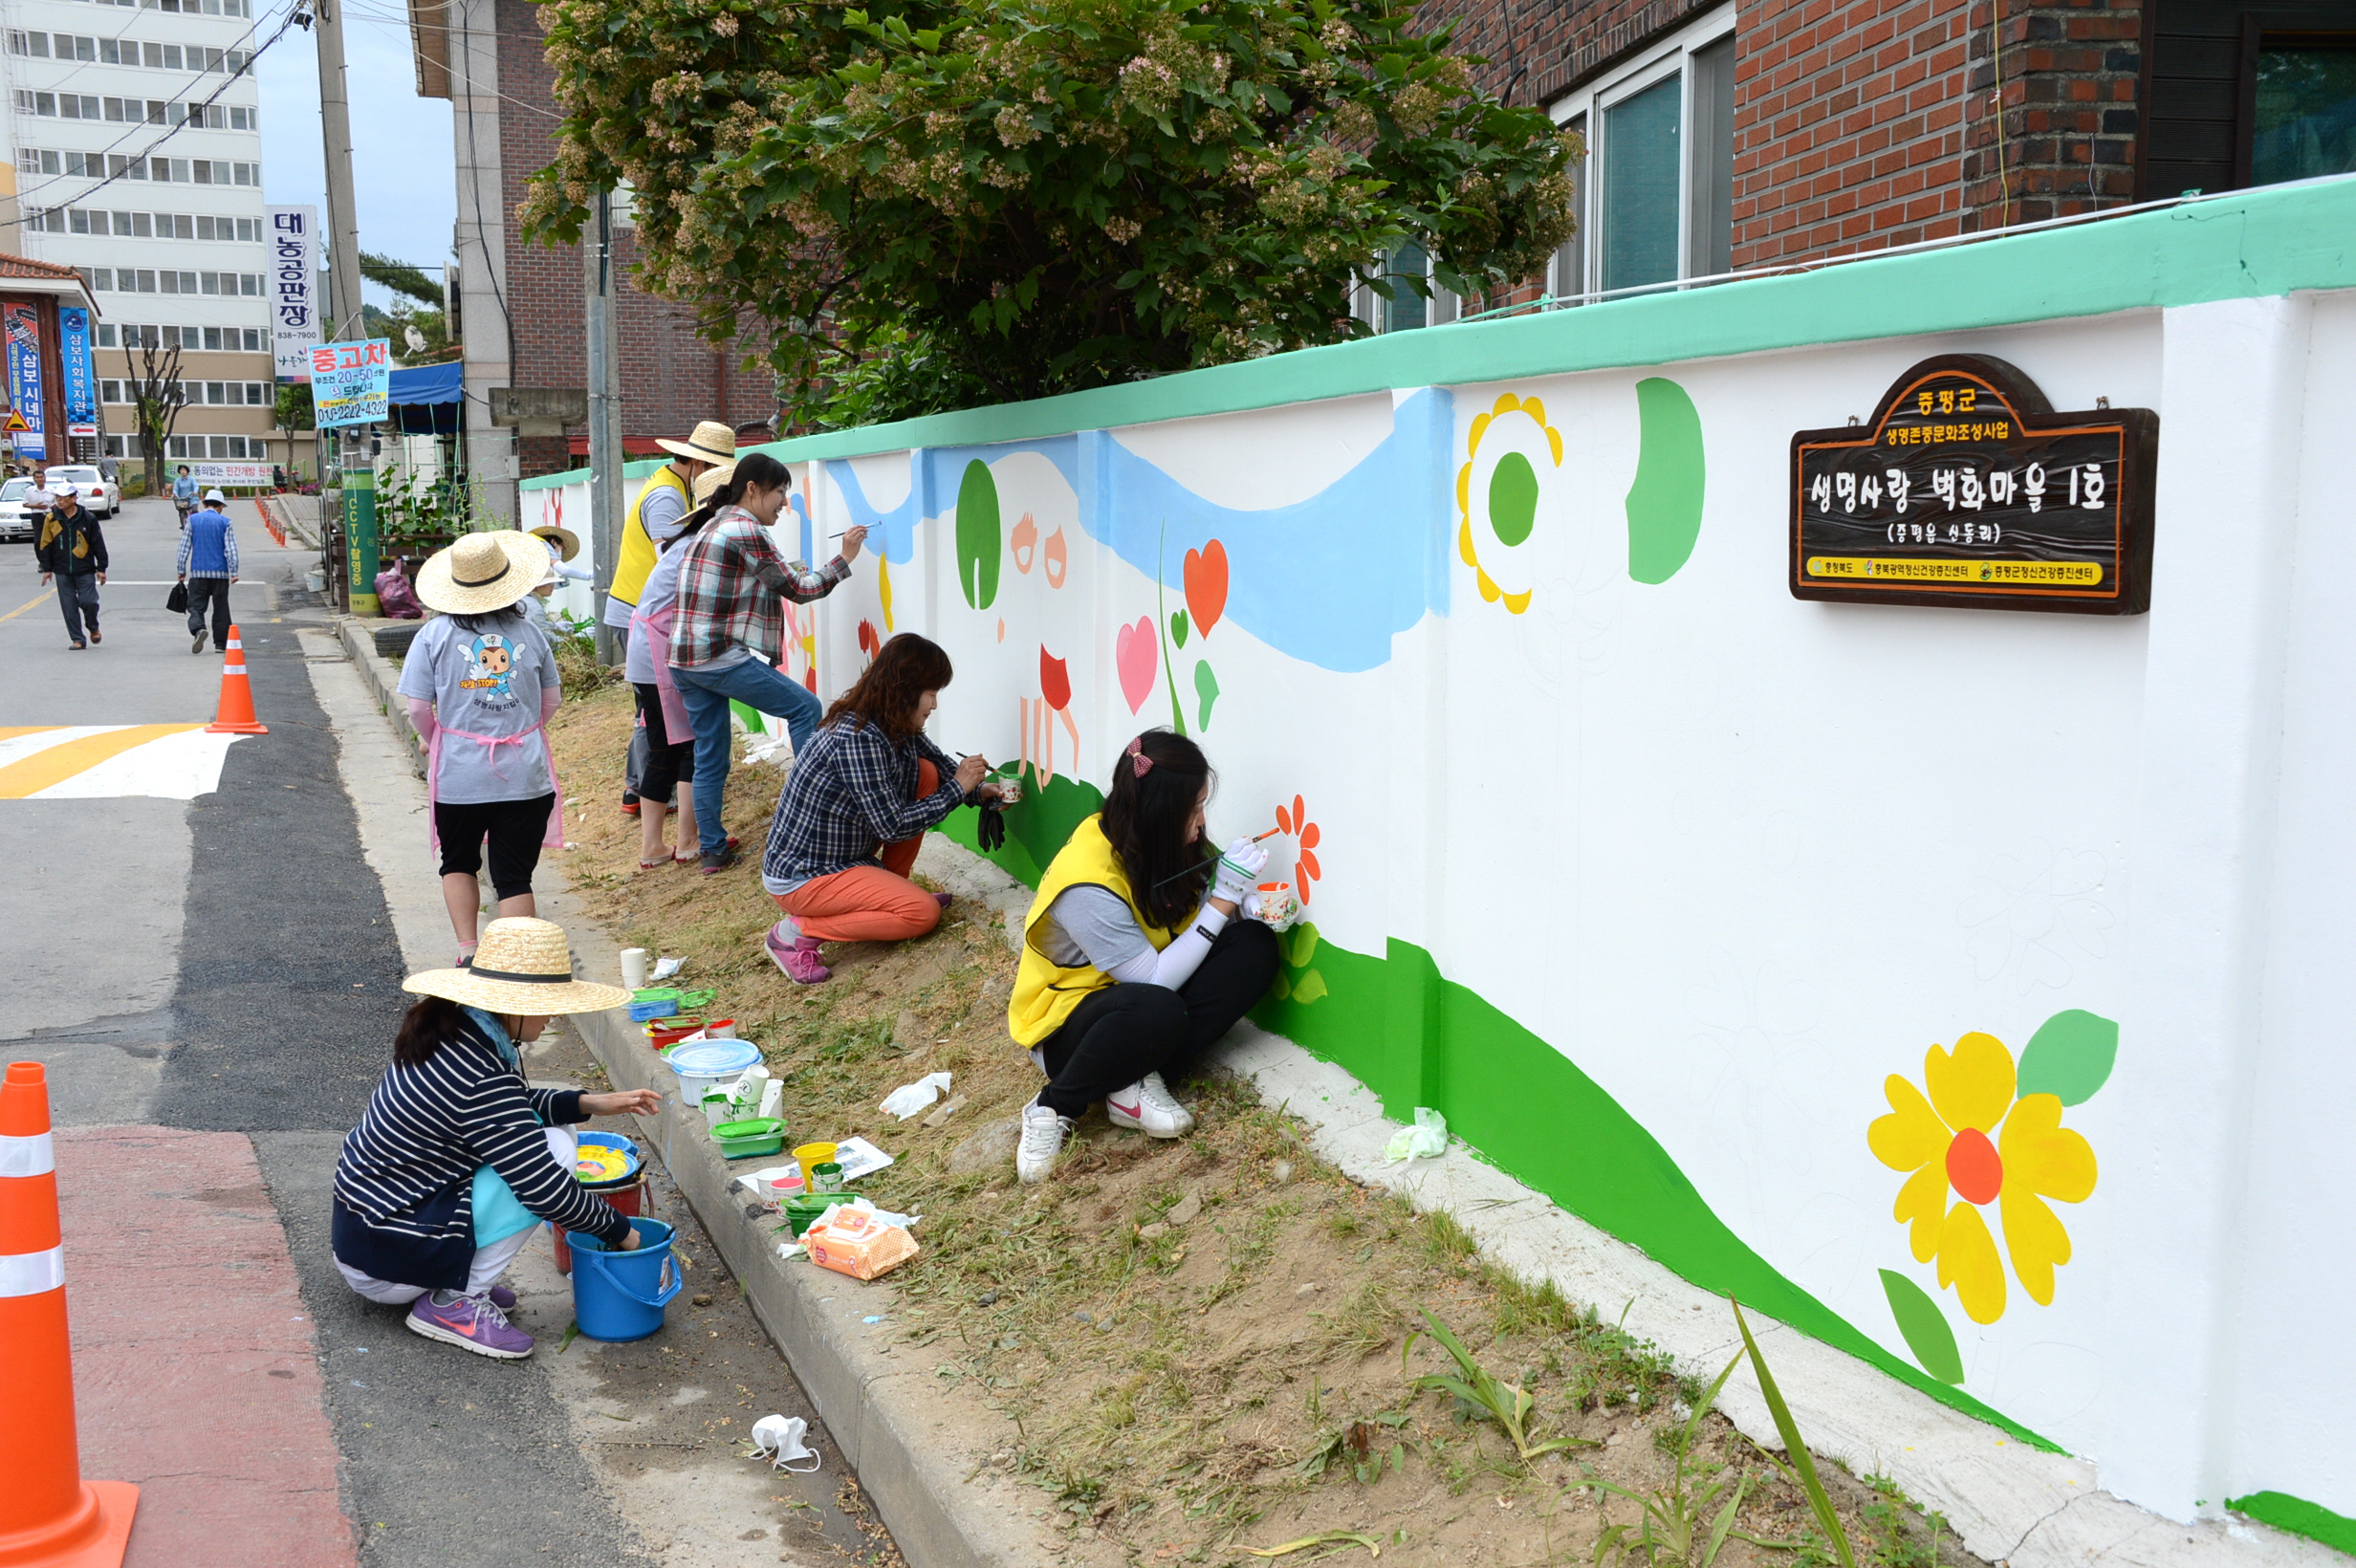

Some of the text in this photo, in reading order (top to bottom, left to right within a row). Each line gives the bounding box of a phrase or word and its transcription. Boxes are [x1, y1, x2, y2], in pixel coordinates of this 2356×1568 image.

[273, 213, 309, 327] 대농공판장
[277, 331, 316, 339] 838-7900
[22, 354, 37, 382] 삼보
[277, 355, 309, 367] 나들가
[312, 342, 387, 373] 중고차
[69, 334, 88, 412] 삼보사회복지관
[315, 376, 336, 385] 무조건
[24, 386, 42, 431] 시네마
[1918, 388, 1976, 416] 증평군
[1887, 422, 2009, 446] 생명존중문화조성사업
[193, 465, 224, 476] 동의없는
[226, 466, 256, 477] 민간개방
[1811, 462, 2105, 514] 생명사랑 벽화마을 1호
[1887, 523, 2001, 544] (증평읍 신동리)
[1825, 562, 2093, 579] 충청북도 충북광역정신건강증진센터 증평군정신건강증진센터
[460, 678, 498, 689] 자살 STOP!
